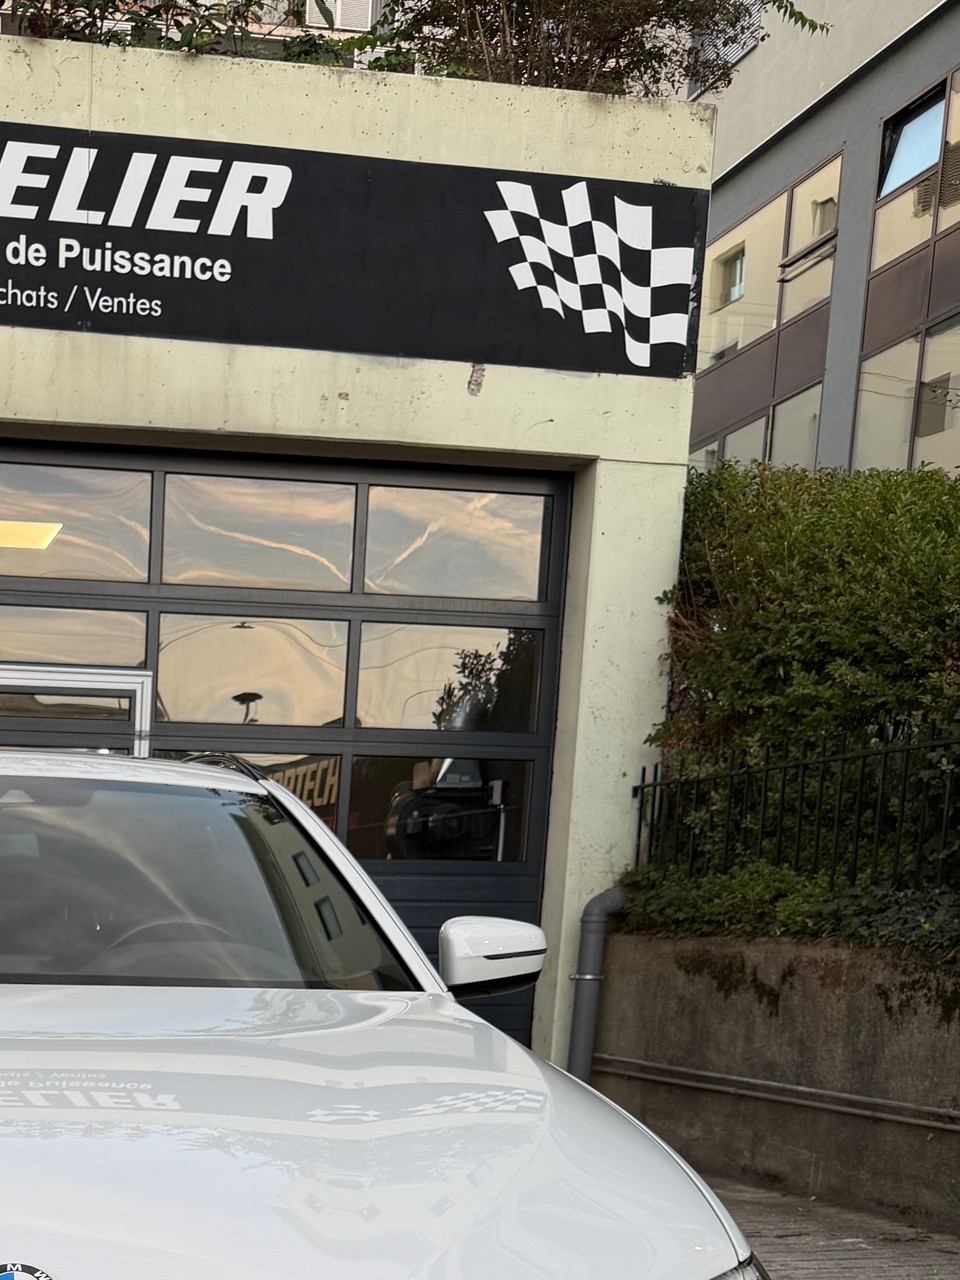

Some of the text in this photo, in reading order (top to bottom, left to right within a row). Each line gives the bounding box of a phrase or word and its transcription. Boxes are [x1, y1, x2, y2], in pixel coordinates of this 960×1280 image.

[5, 235, 46, 267] de
[58, 238, 232, 282] Puissance
[63, 285, 78, 313] /
[83, 286, 162, 316] Ventes
